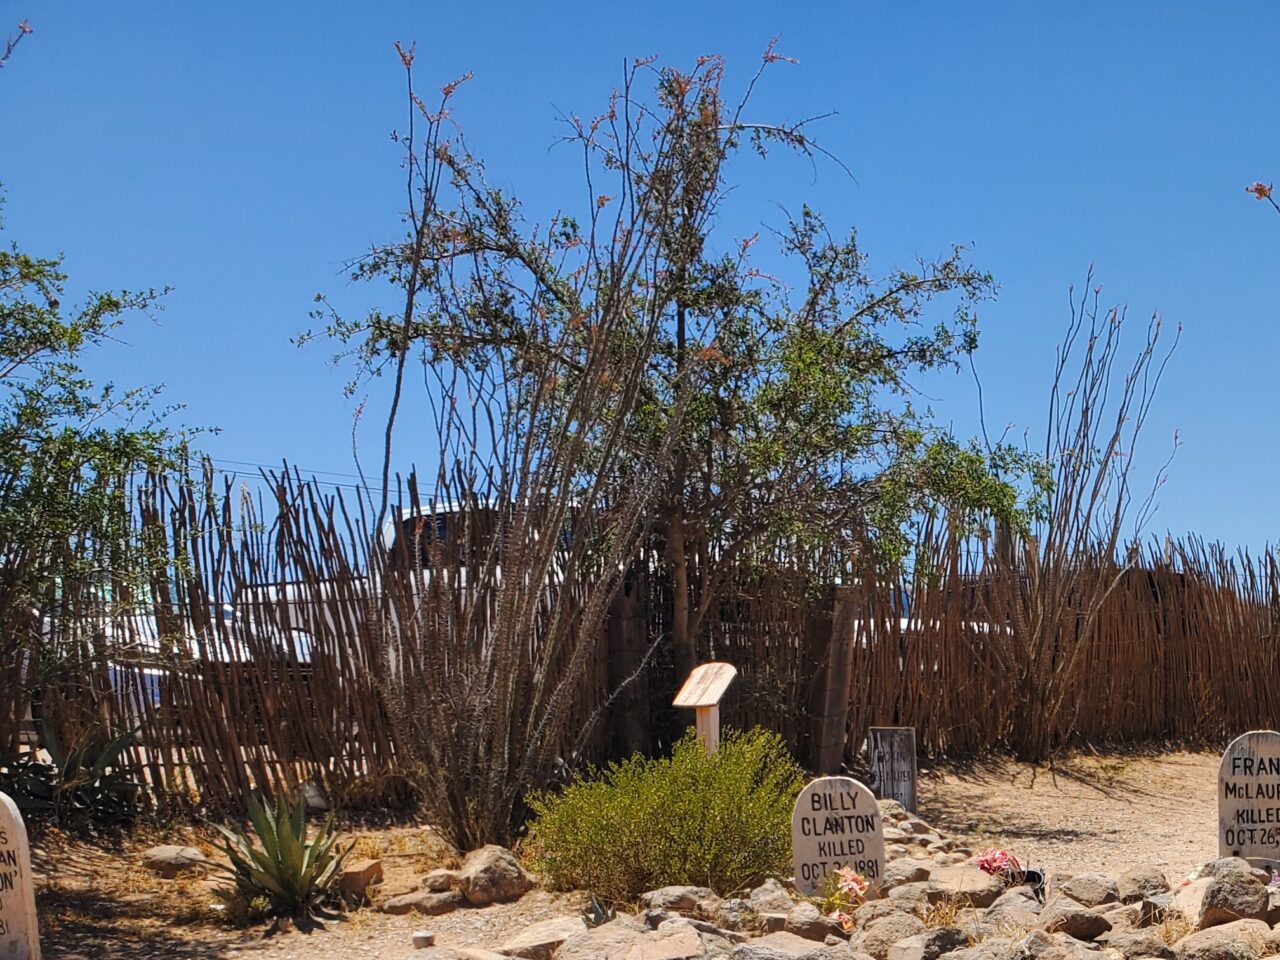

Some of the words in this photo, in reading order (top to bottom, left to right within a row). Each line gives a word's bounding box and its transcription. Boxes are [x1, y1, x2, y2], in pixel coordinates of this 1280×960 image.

[811, 791, 858, 811] BILLY
[801, 815, 876, 836] CLANTON
[1226, 828, 1257, 846] OCT.
[818, 839, 864, 857] KILLED
